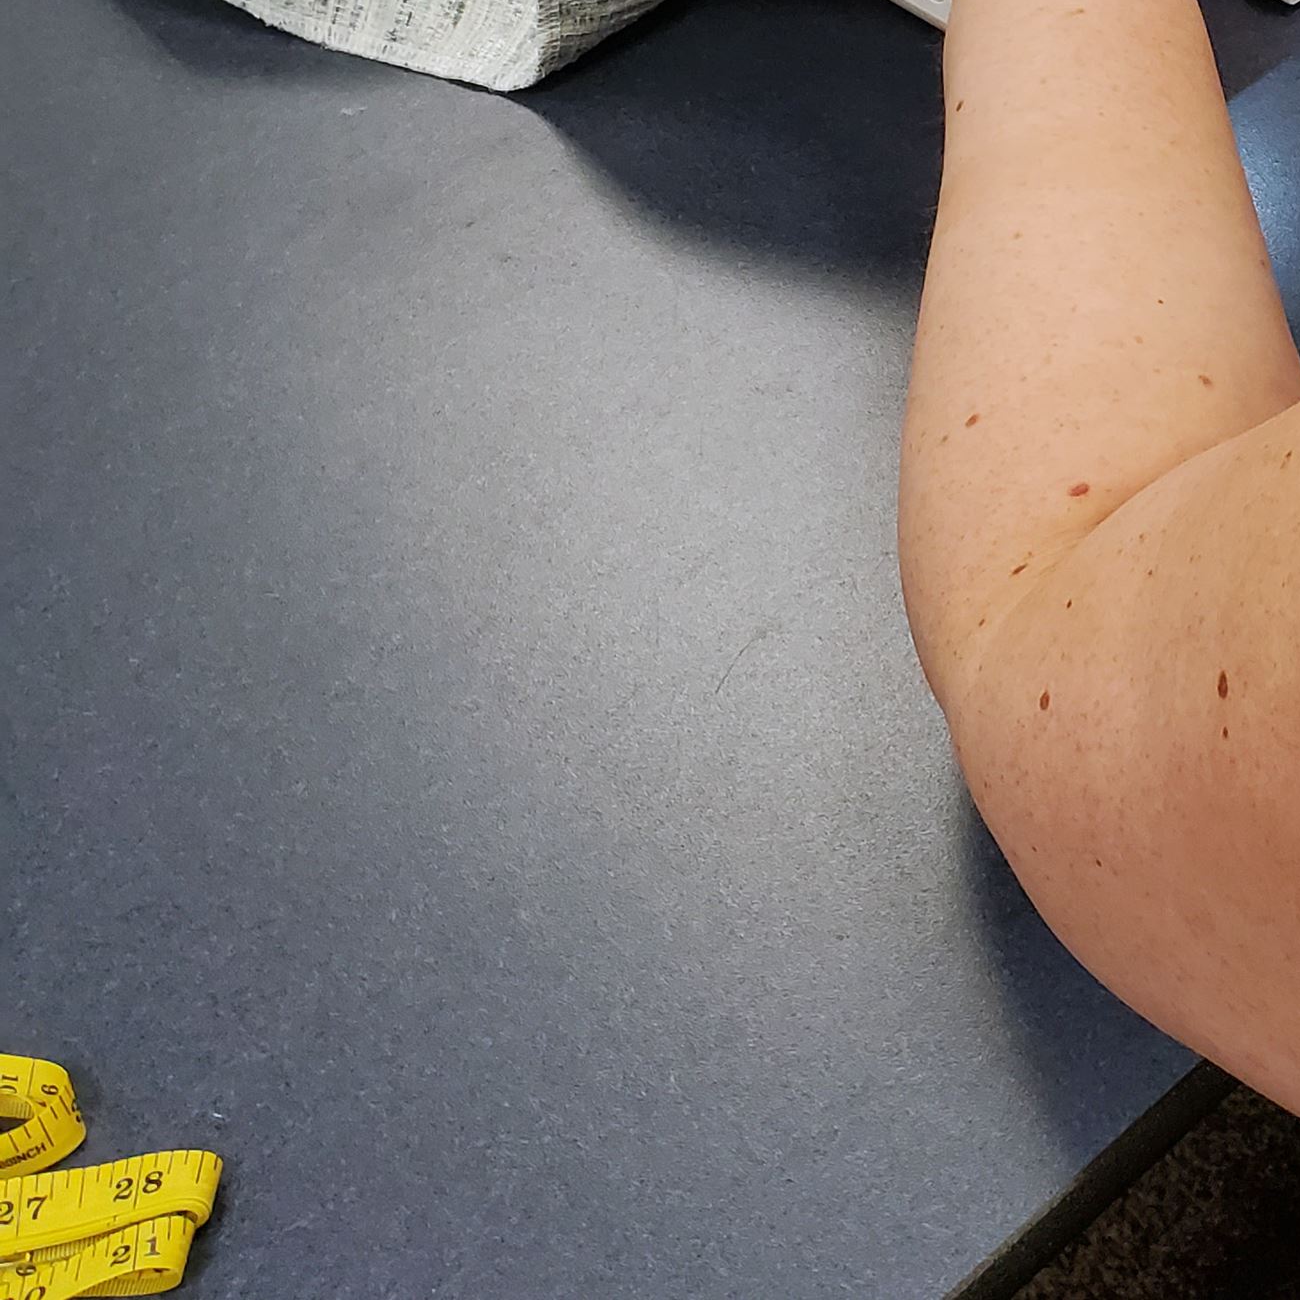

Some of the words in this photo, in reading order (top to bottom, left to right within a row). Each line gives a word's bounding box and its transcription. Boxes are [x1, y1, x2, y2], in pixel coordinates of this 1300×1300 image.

[113, 1171, 164, 1202] 28
[0, 1195, 48, 1225] 27
[110, 1236, 161, 1267] 21
